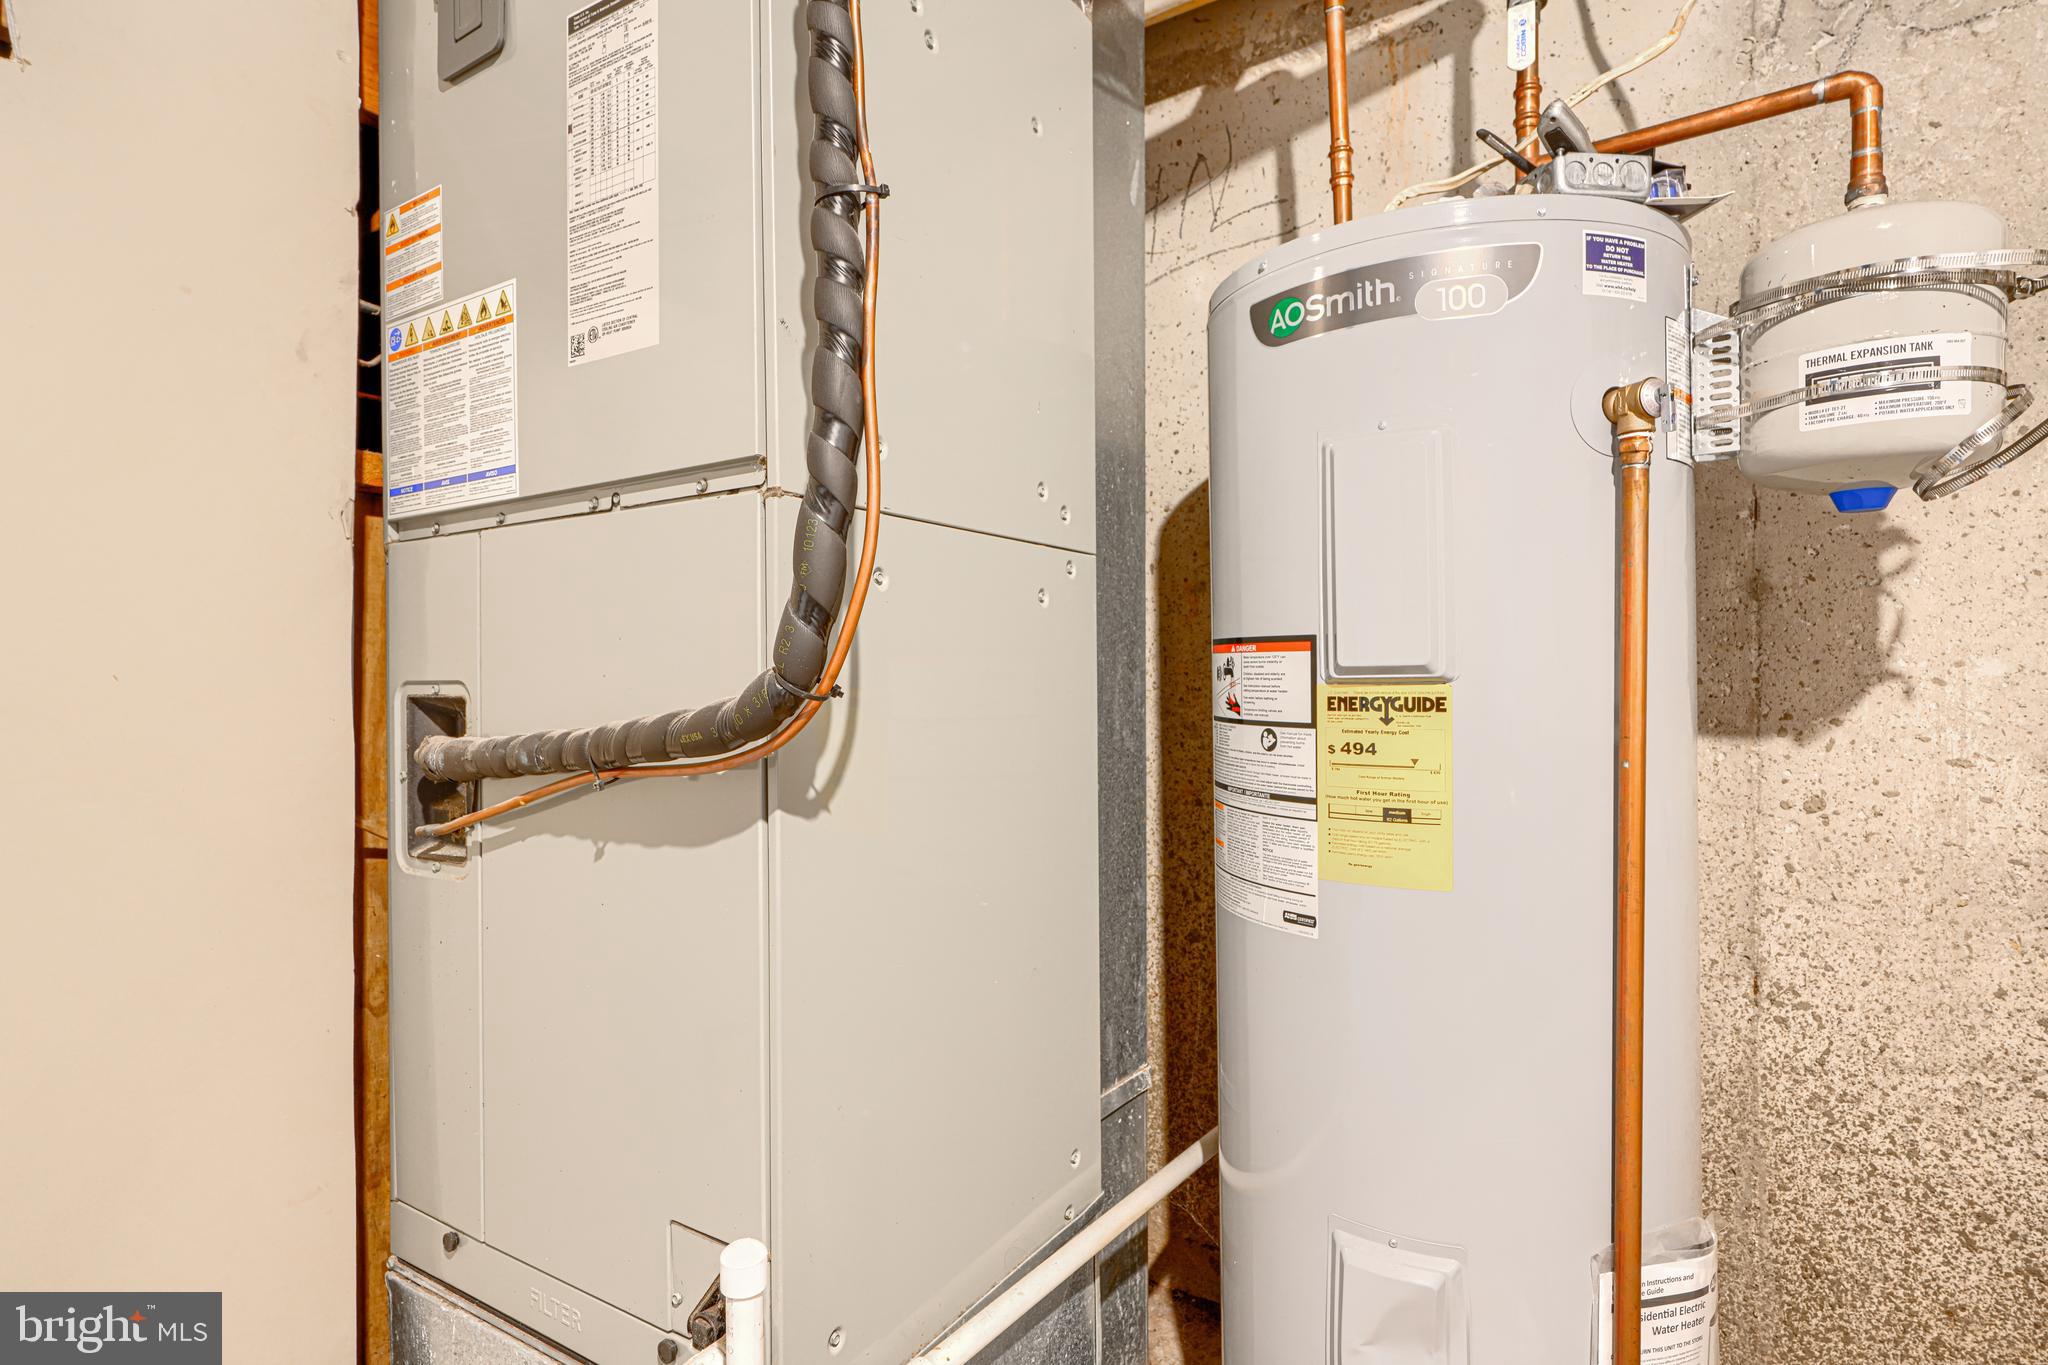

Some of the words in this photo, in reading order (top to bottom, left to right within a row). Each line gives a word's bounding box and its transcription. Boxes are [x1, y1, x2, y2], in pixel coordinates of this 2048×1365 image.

[1616, 246, 1629, 254] NOT
[1624, 240, 1645, 249] PROBLEM
[1408, 260, 1514, 280] SIGNATURE
[1436, 283, 1487, 312] 100
[1806, 353, 1848, 368] THERMAL
[1850, 343, 1907, 360] EXPANSION
[1909, 341, 1933, 351] TANK
[802, 518, 818, 551] 10123
[1327, 696, 1447, 713] ENERGYGUIDE
[1340, 742, 1377, 756] 494
[1647, 1276, 1682, 1287] Instructions
[528, 1287, 583, 1334] FILTER
[1679, 1301, 1706, 1316] Electric
[1652, 1323, 1678, 1336] Water
[1681, 1316, 1705, 1330] Heater
